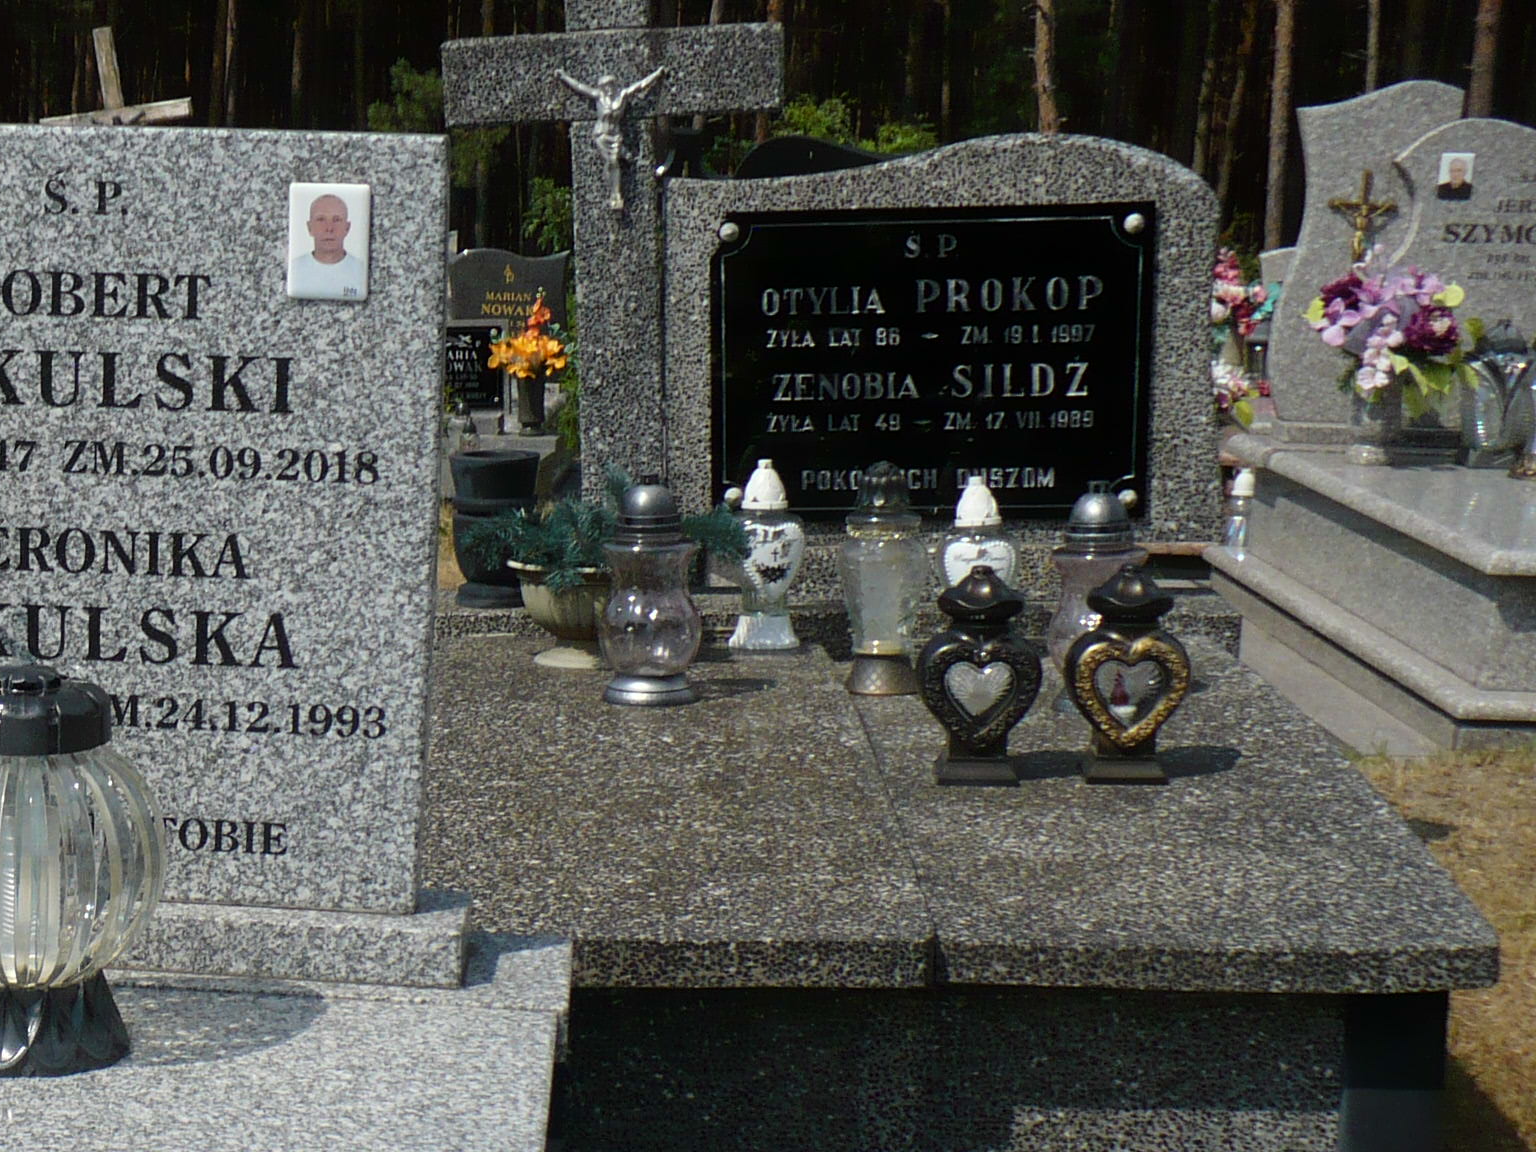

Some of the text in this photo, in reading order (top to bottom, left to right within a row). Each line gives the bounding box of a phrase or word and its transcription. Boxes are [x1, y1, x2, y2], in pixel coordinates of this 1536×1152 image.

[95, 180, 128, 215] P.
[1494, 199, 1536, 213] JER
[486, 291, 532, 302] MARIAN
[762, 275, 1104, 316] OTYLIA PROKOP
[829, 328, 862, 347] LAT
[875, 327, 901, 347] 86
[448, 350, 477, 360] ARIA
[773, 372, 920, 401] ZENOBIA
[828, 414, 860, 431] LAT
[64, 440, 379, 484] ZM.25.09.2018
[109, 693, 386, 740] M.24.12.1993
